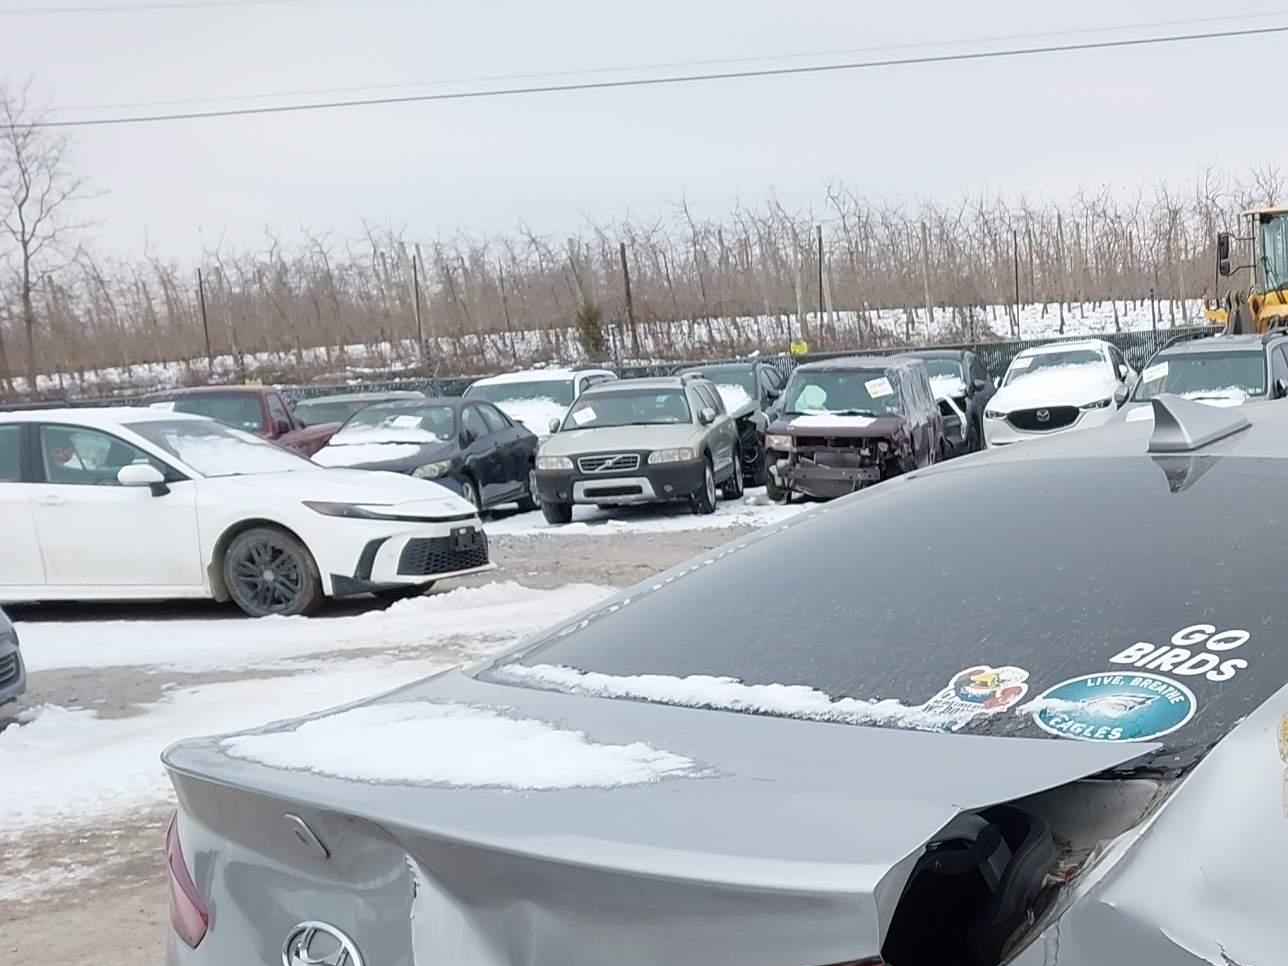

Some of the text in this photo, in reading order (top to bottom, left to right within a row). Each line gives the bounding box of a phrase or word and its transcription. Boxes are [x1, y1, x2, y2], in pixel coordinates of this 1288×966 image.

[1171, 624, 1251, 651] GO
[1109, 641, 1249, 682] BIRDS
[1086, 675, 1185, 705] LIVE, BREATHE
